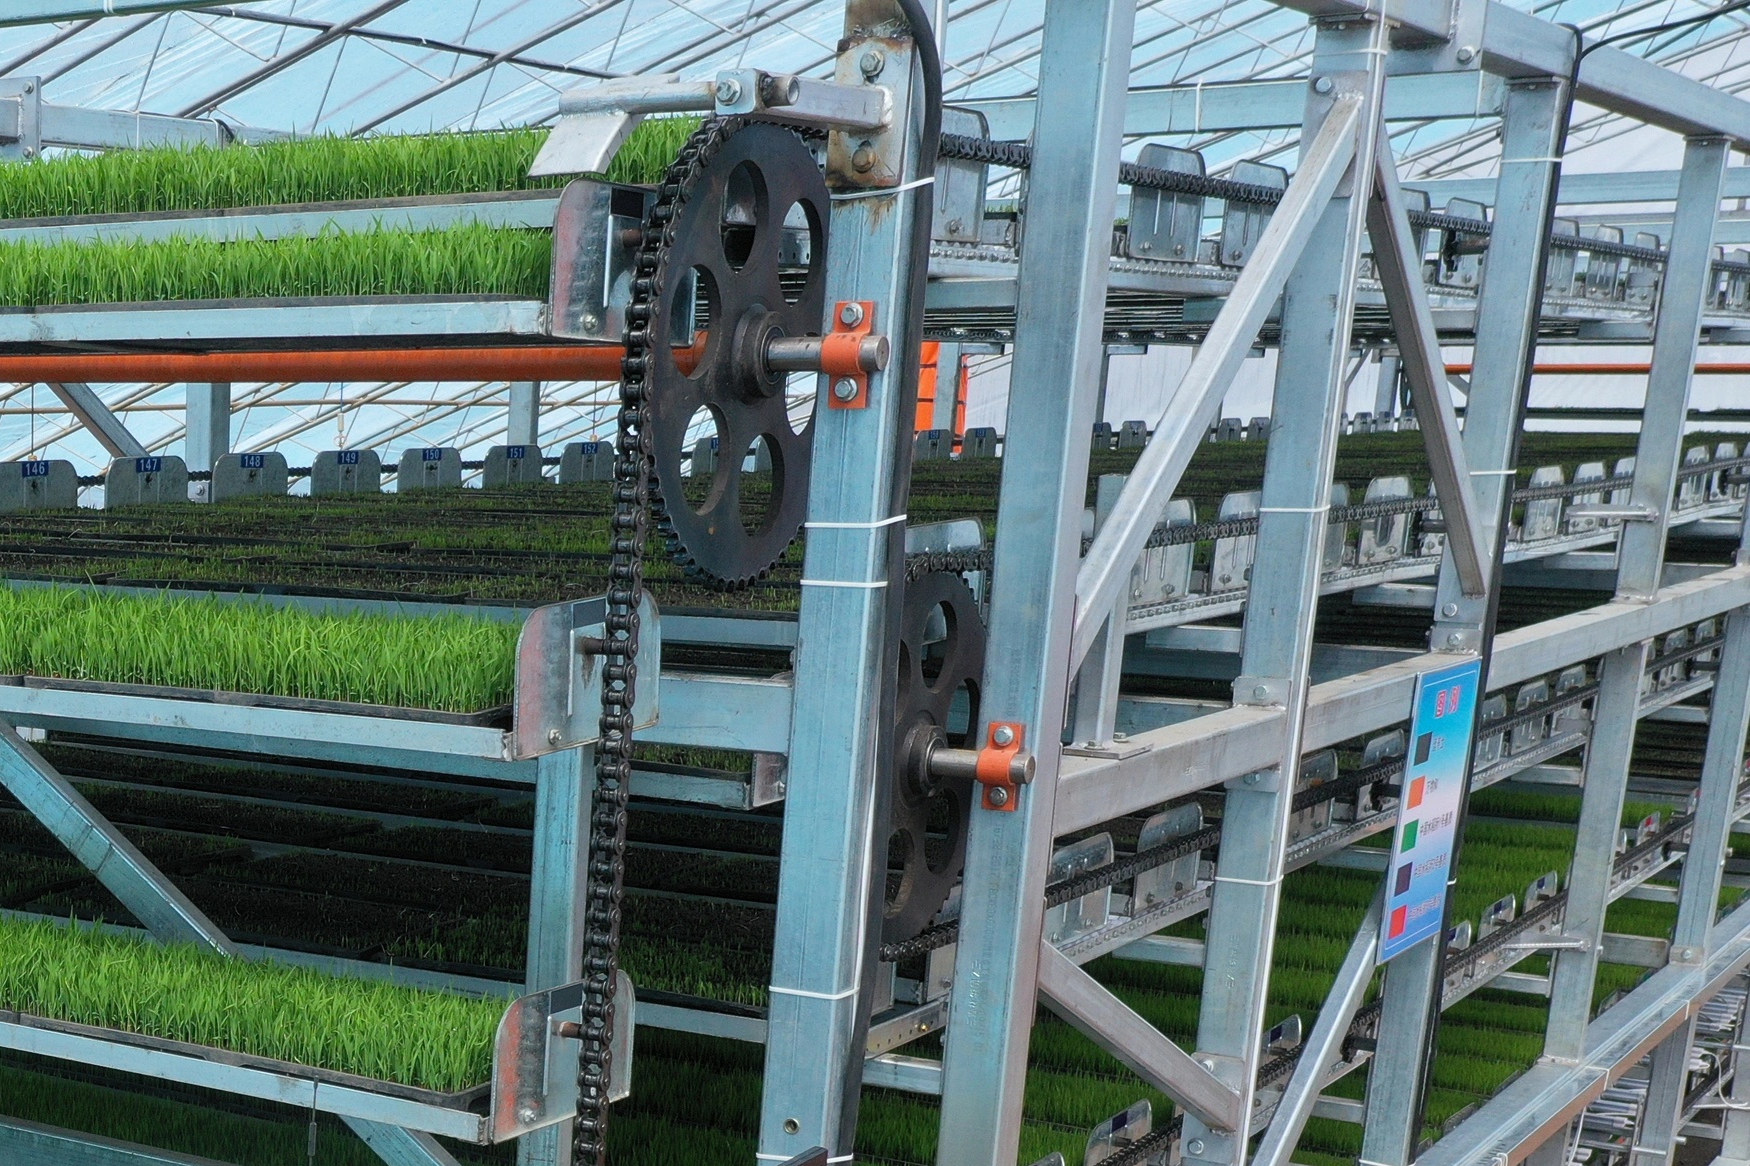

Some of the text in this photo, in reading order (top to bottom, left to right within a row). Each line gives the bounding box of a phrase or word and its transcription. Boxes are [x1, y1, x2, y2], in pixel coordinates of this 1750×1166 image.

[509, 447, 523, 458] 151
[583, 443, 596, 454] 152
[340, 452, 356, 463] 149
[424, 449, 440, 460] 150
[139, 458, 158, 471] 147
[244, 455, 261, 467] 148
[25, 463, 46, 476] 146
